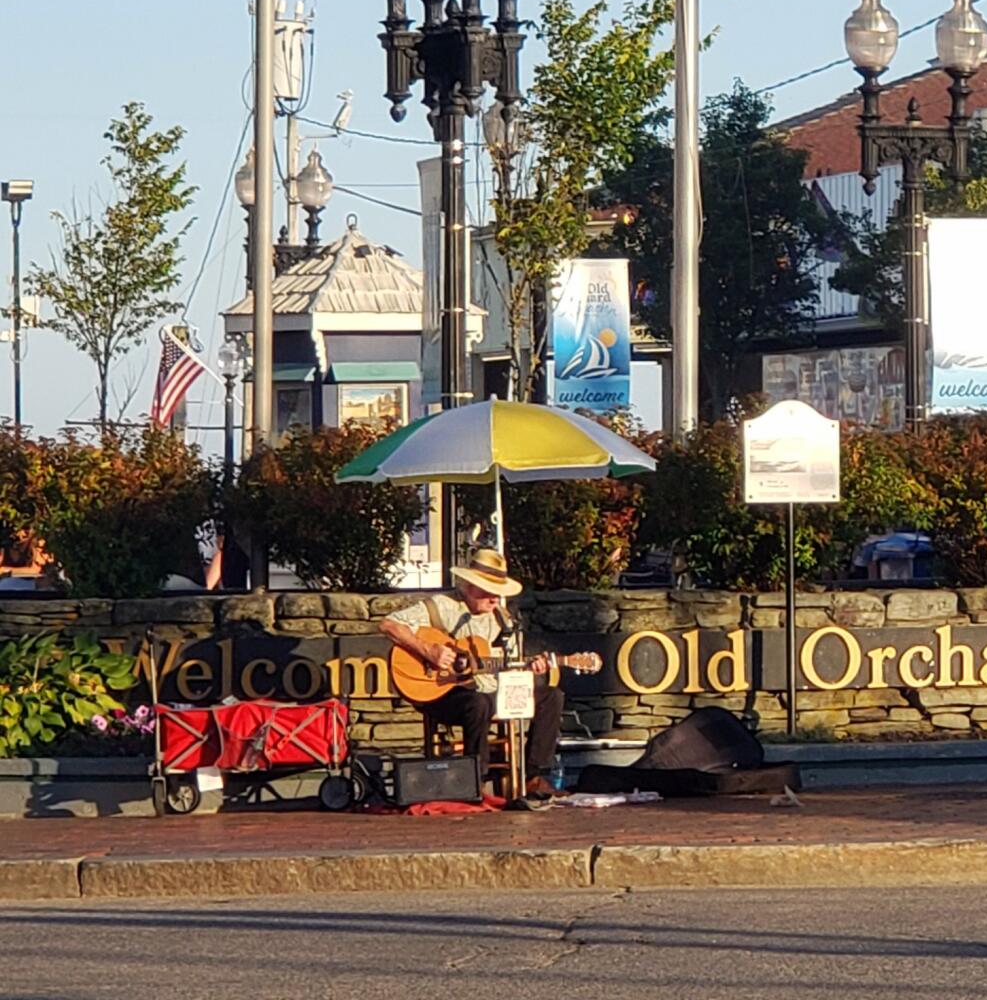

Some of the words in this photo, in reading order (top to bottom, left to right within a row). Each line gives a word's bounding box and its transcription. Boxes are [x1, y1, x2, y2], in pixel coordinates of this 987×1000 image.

[559, 387, 625, 403] welcome
[100, 636, 401, 701] Welcom
[617, 629, 749, 694] Old
